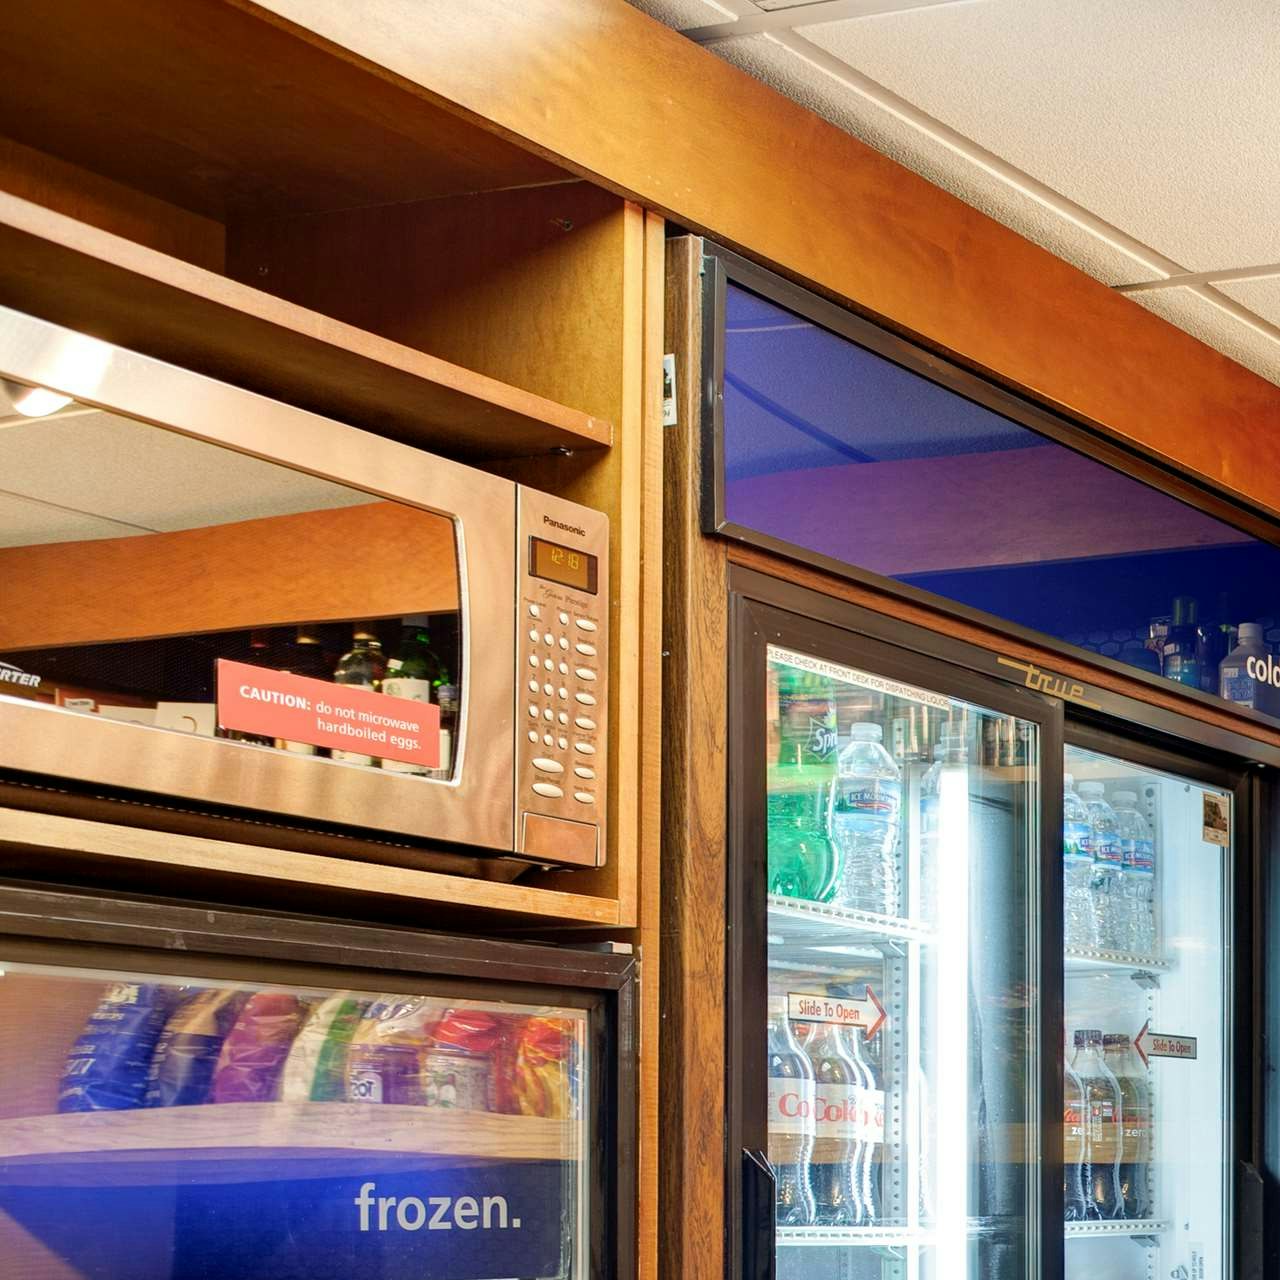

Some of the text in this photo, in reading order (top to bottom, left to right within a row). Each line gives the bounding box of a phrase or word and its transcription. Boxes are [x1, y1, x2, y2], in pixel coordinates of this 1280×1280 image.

[543, 515, 586, 537] Panasonic
[0, 668, 41, 687] RTER
[829, 665, 851, 679] FRONT
[240, 685, 419, 733] CAUTION: do not microwave
[317, 718, 422, 751] hardboiled eggs.
[799, 999, 860, 1021] Slide To Open
[354, 1182, 522, 1232] frozen.
